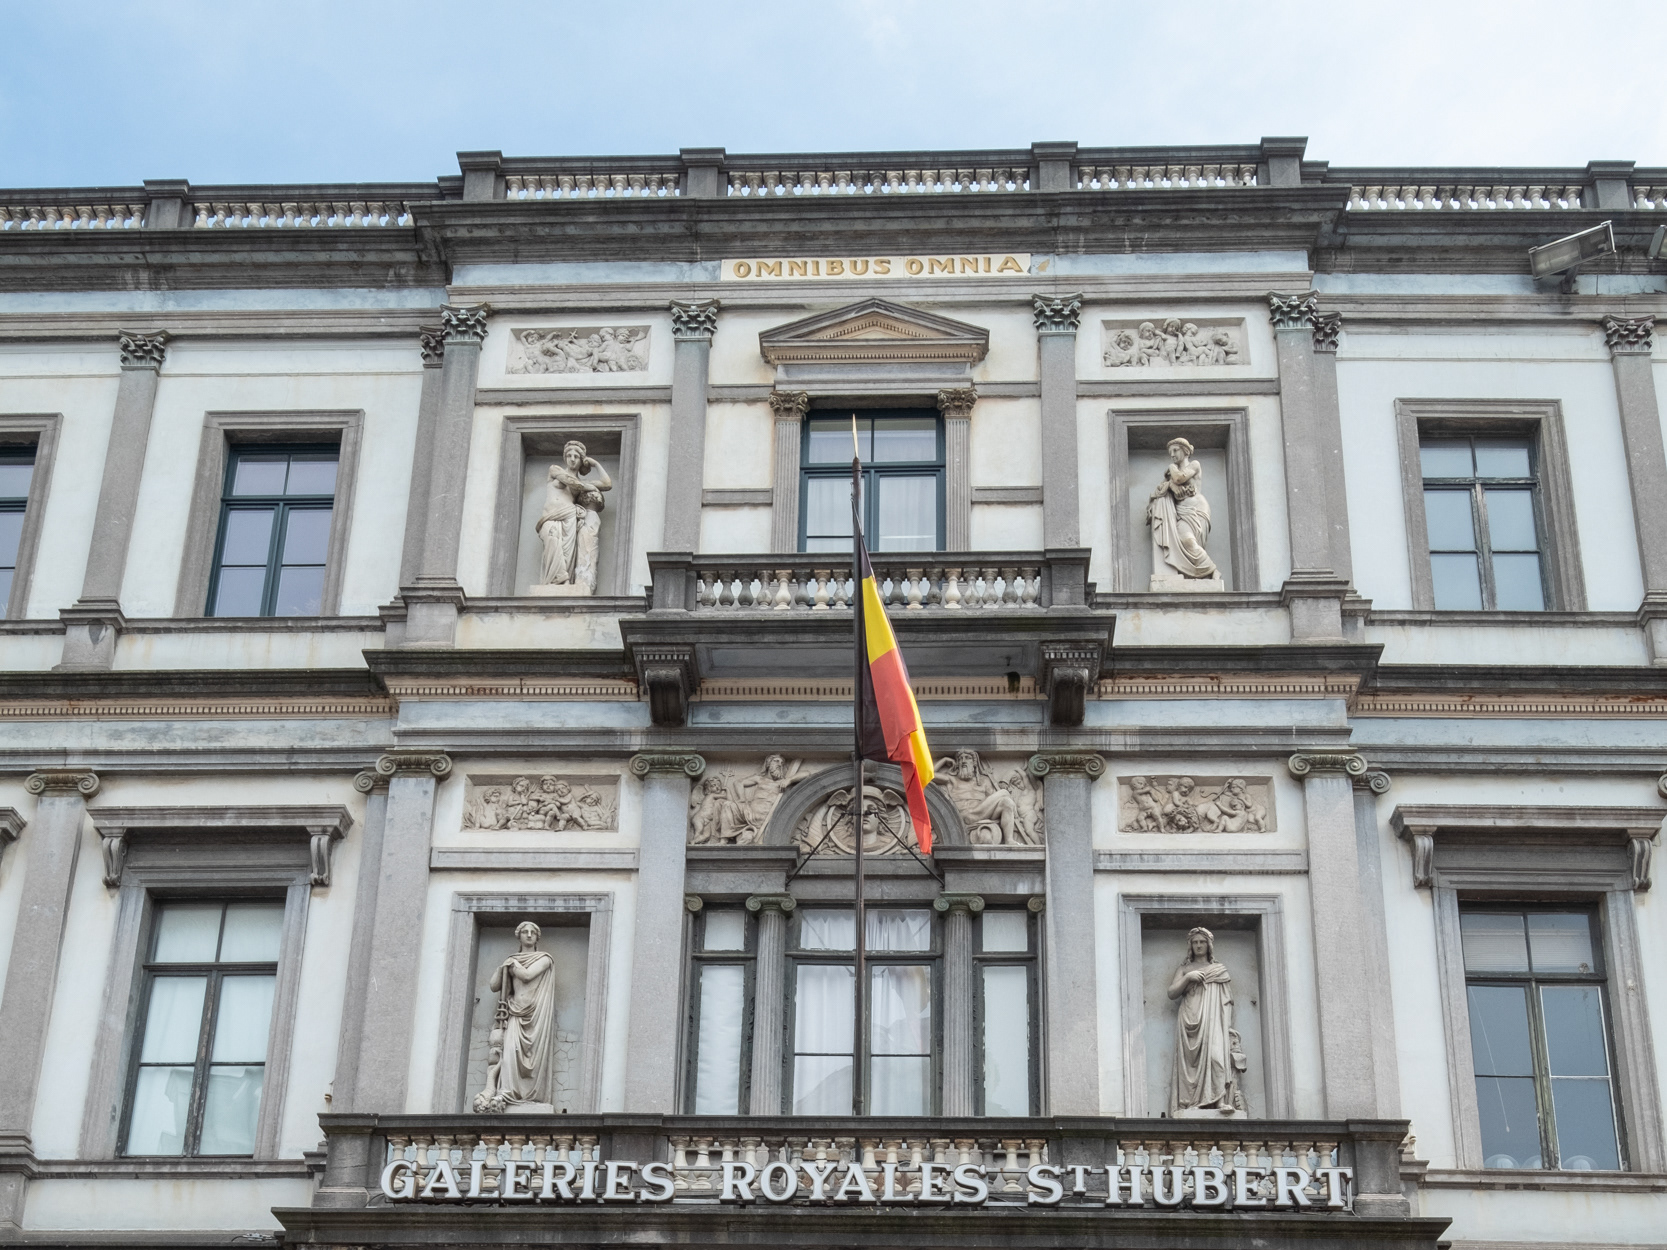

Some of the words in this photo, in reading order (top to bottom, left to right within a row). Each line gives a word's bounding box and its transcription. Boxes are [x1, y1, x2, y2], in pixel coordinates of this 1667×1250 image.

[733, 257, 892, 277] OMNIBUS
[905, 255, 1024, 275] OMNIA
[380, 1159, 676, 1201] GALERIES
[720, 1162, 989, 1204] ROYALES
[1106, 1164, 1353, 1209] HUBERT
